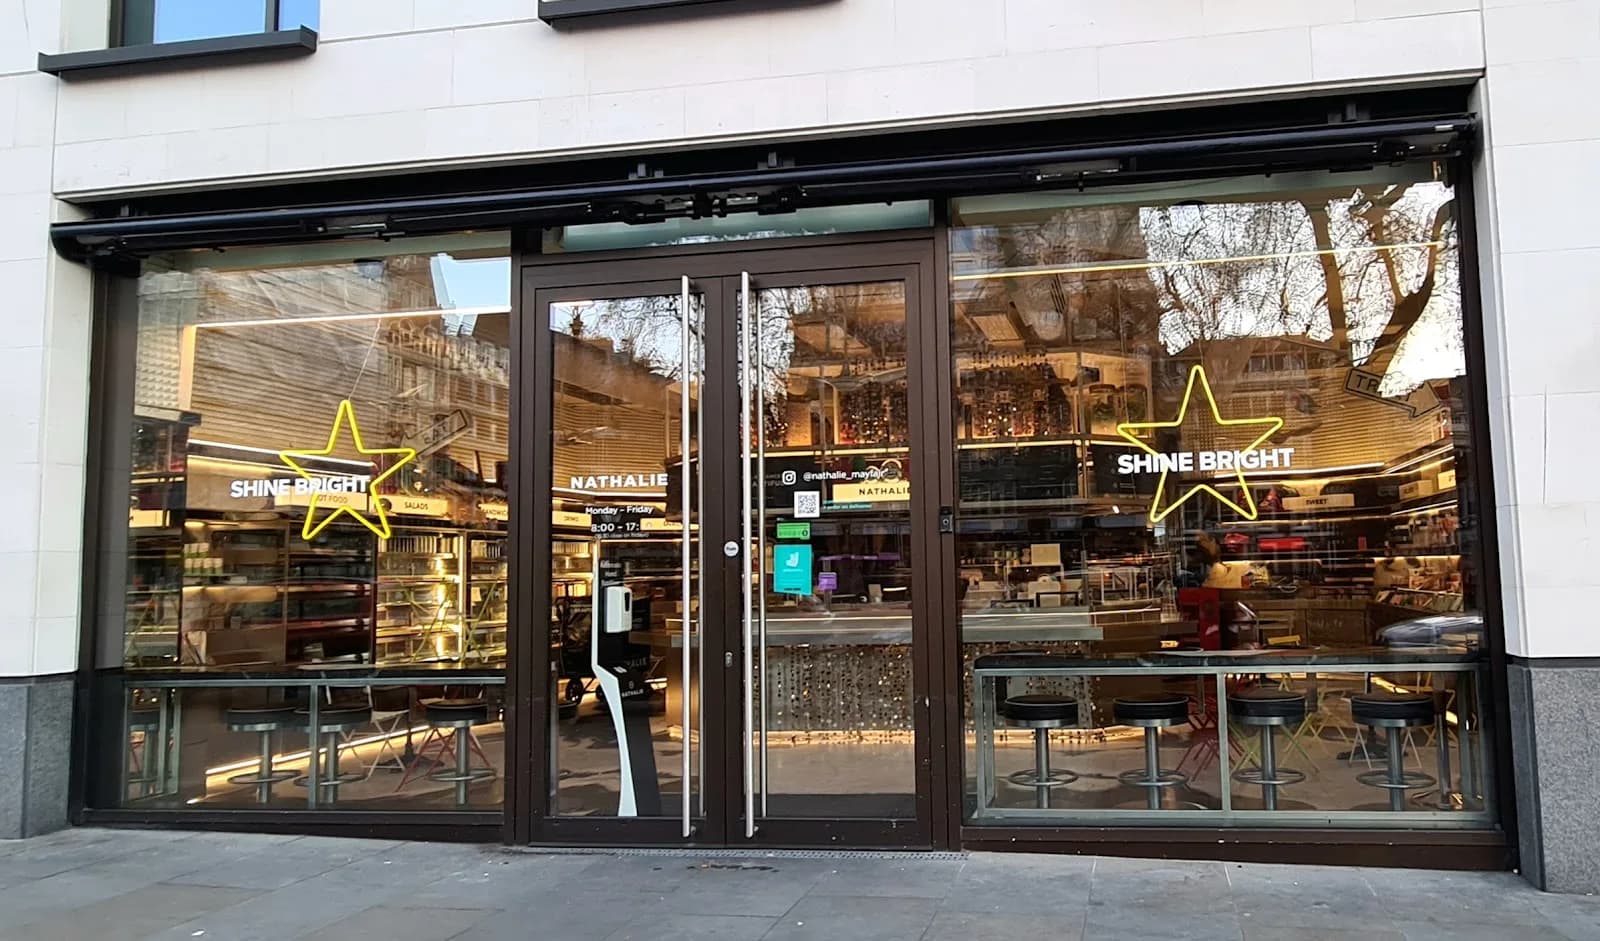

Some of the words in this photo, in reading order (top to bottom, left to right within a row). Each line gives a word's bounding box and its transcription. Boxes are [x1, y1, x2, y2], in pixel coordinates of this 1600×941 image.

[1117, 452, 1193, 473] SHINE
[1199, 447, 1295, 471] BRIGHT
[230, 479, 290, 498] SHINE
[295, 474, 370, 495] BRIGHT
[570, 473, 668, 489] NATHALIE
[585, 506, 618, 515] Monday
[627, 505, 654, 514] Friday
[625, 522, 640, 531] 17:
